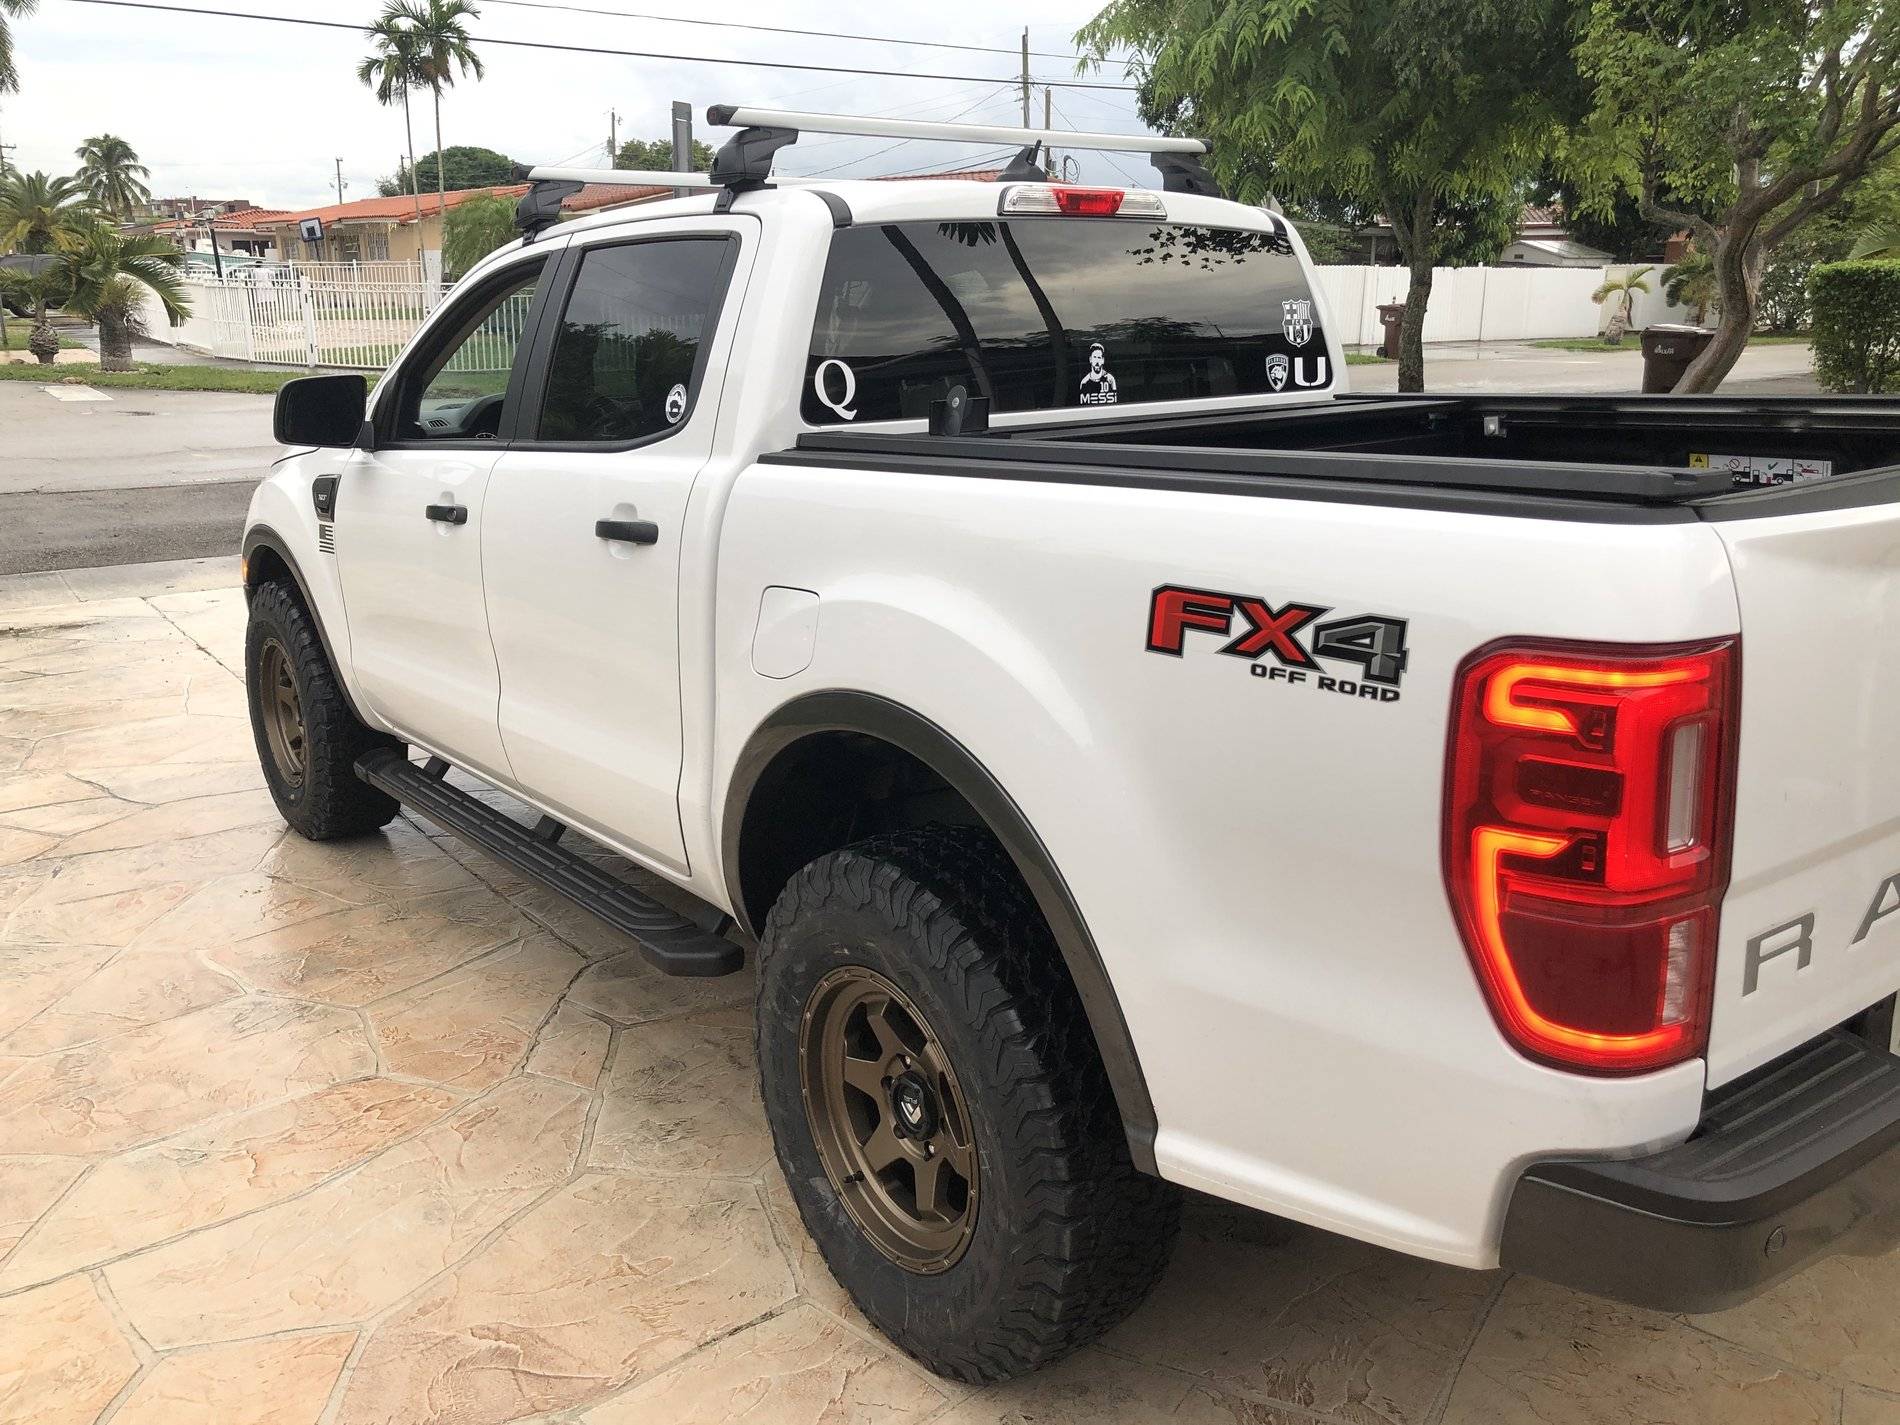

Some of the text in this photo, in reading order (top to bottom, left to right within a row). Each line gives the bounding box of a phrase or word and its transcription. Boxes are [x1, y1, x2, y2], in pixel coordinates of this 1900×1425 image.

[814, 359, 858, 420] Q
[1099, 381, 1109, 393] 10
[1294, 356, 1326, 387] U
[1145, 582, 1410, 688] FX4
[1250, 662, 1401, 703] OFF ROAD
